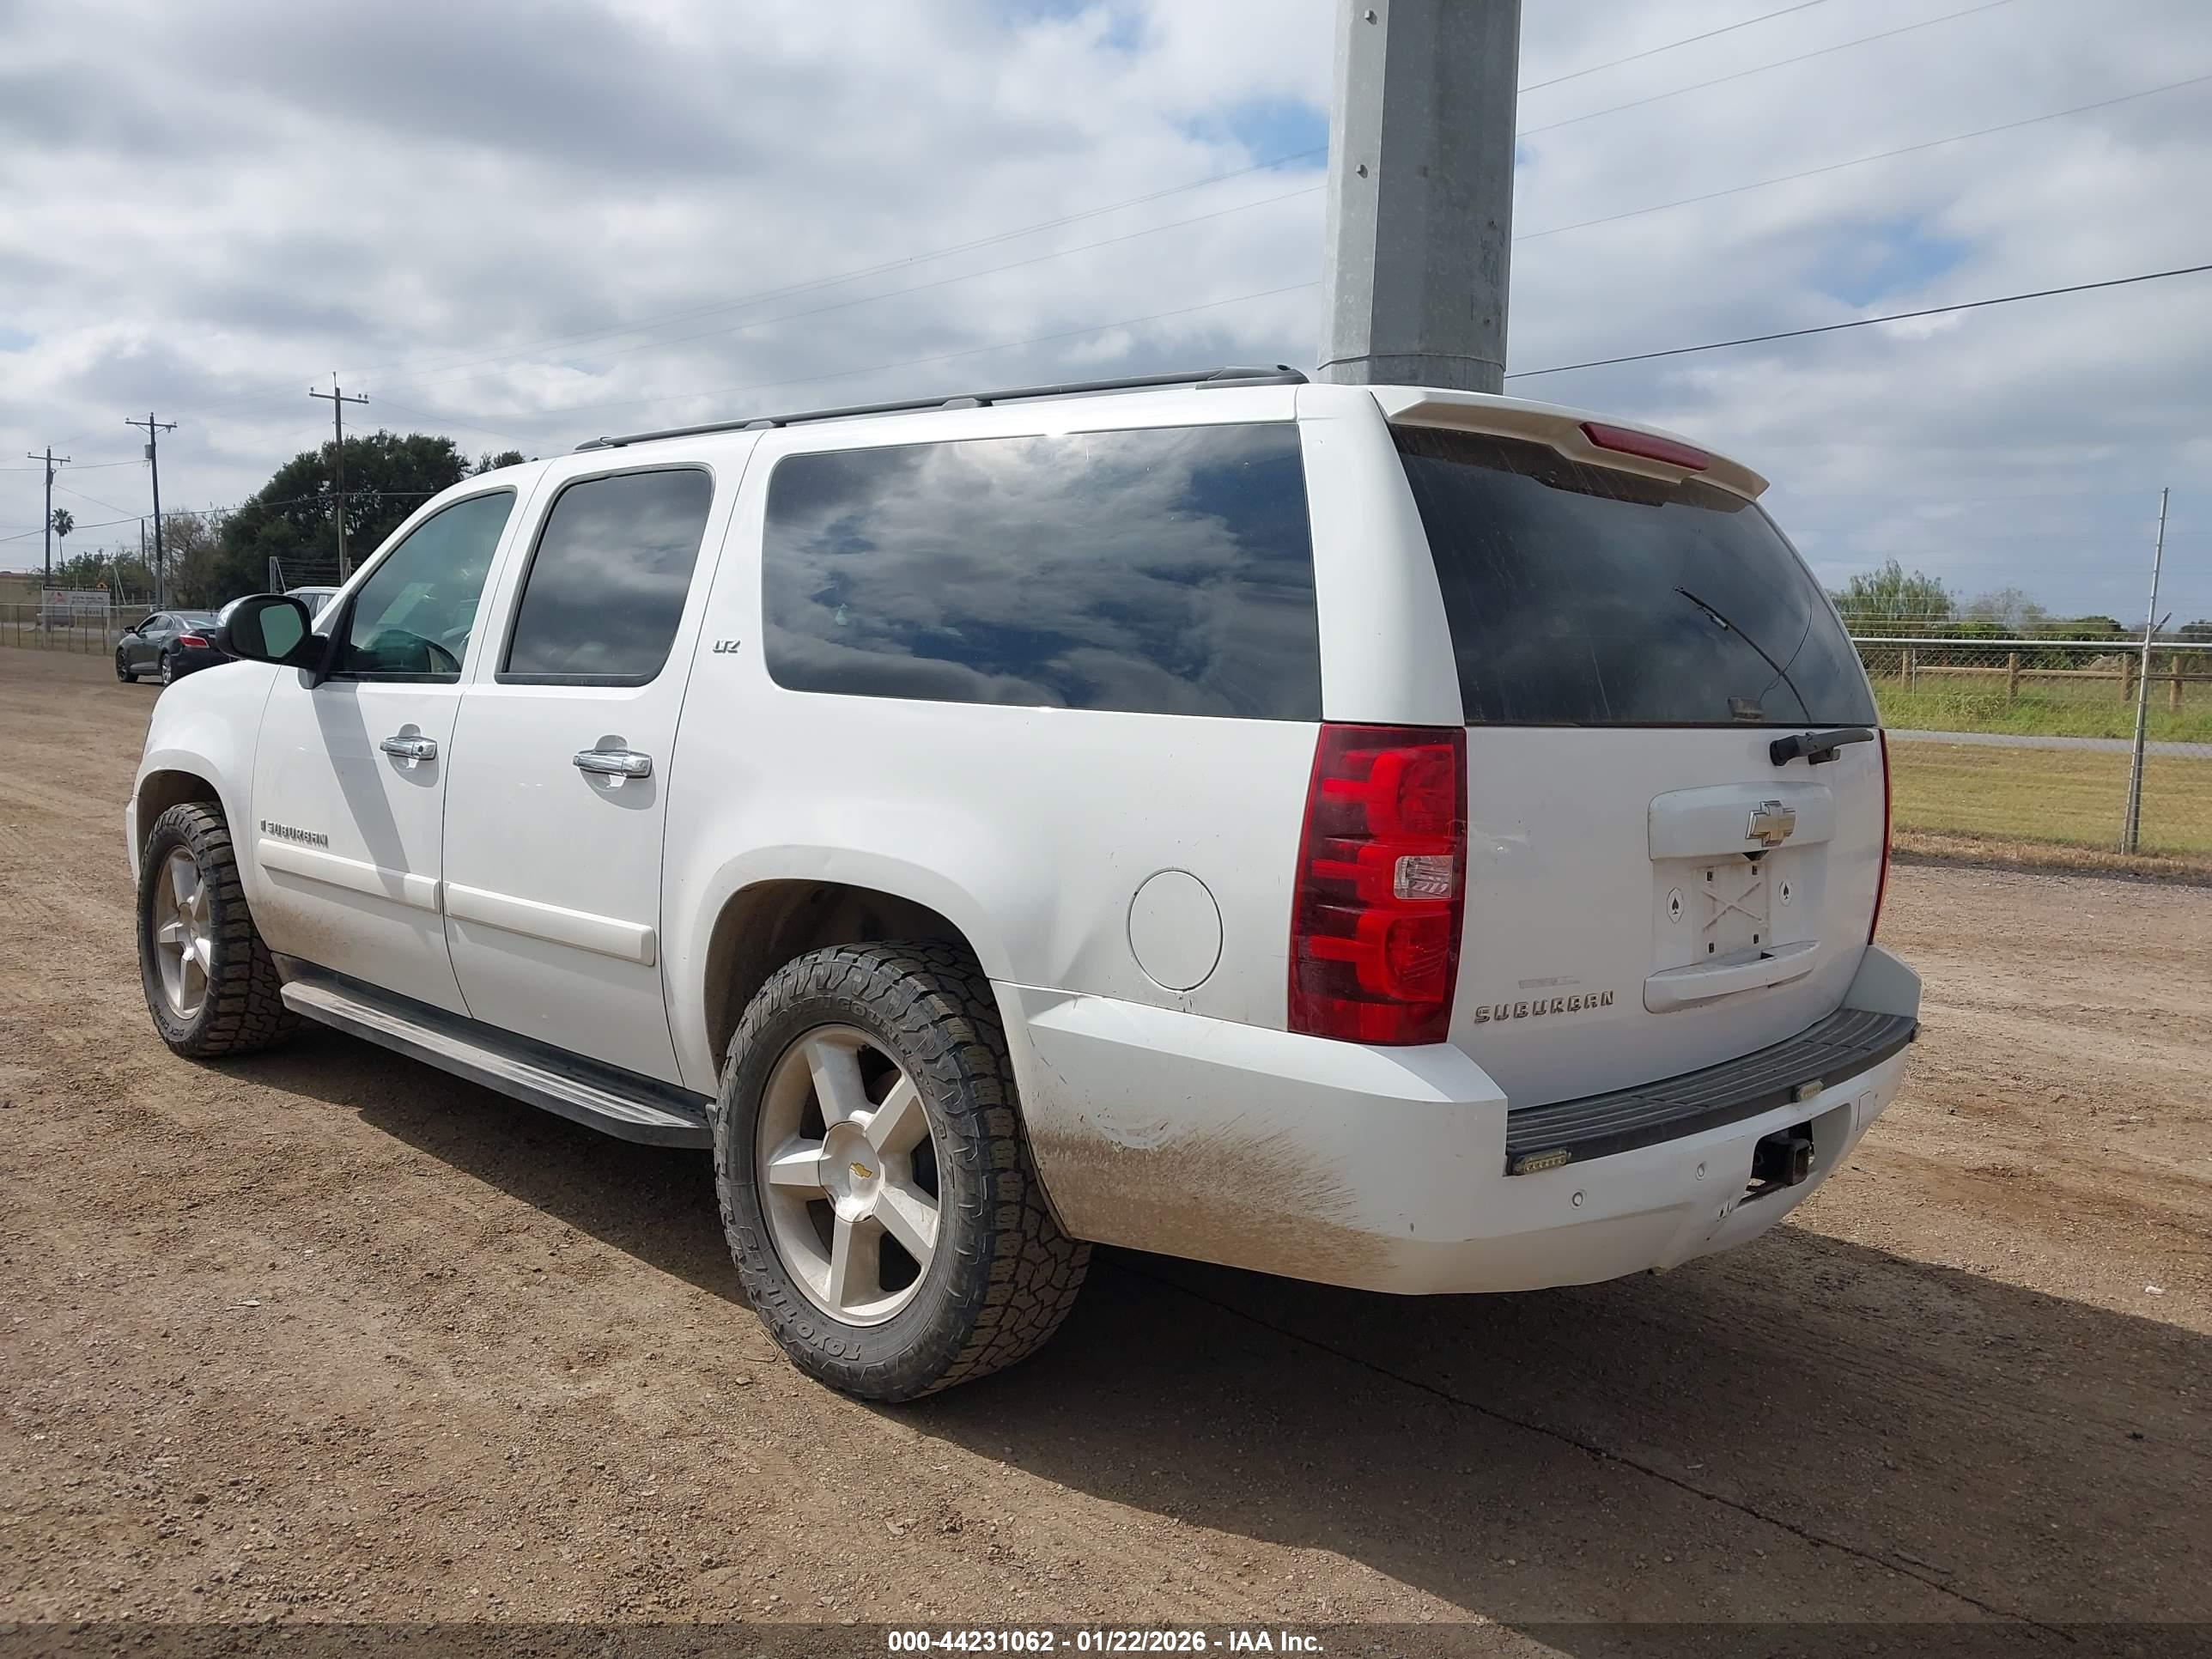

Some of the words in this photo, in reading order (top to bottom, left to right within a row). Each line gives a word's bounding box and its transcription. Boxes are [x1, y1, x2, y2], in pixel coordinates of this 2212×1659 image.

[267, 821, 329, 848] SUBURBAN
[1474, 990, 1614, 1024] SUBURBAN
[795, 1318, 861, 1360] TOYO
